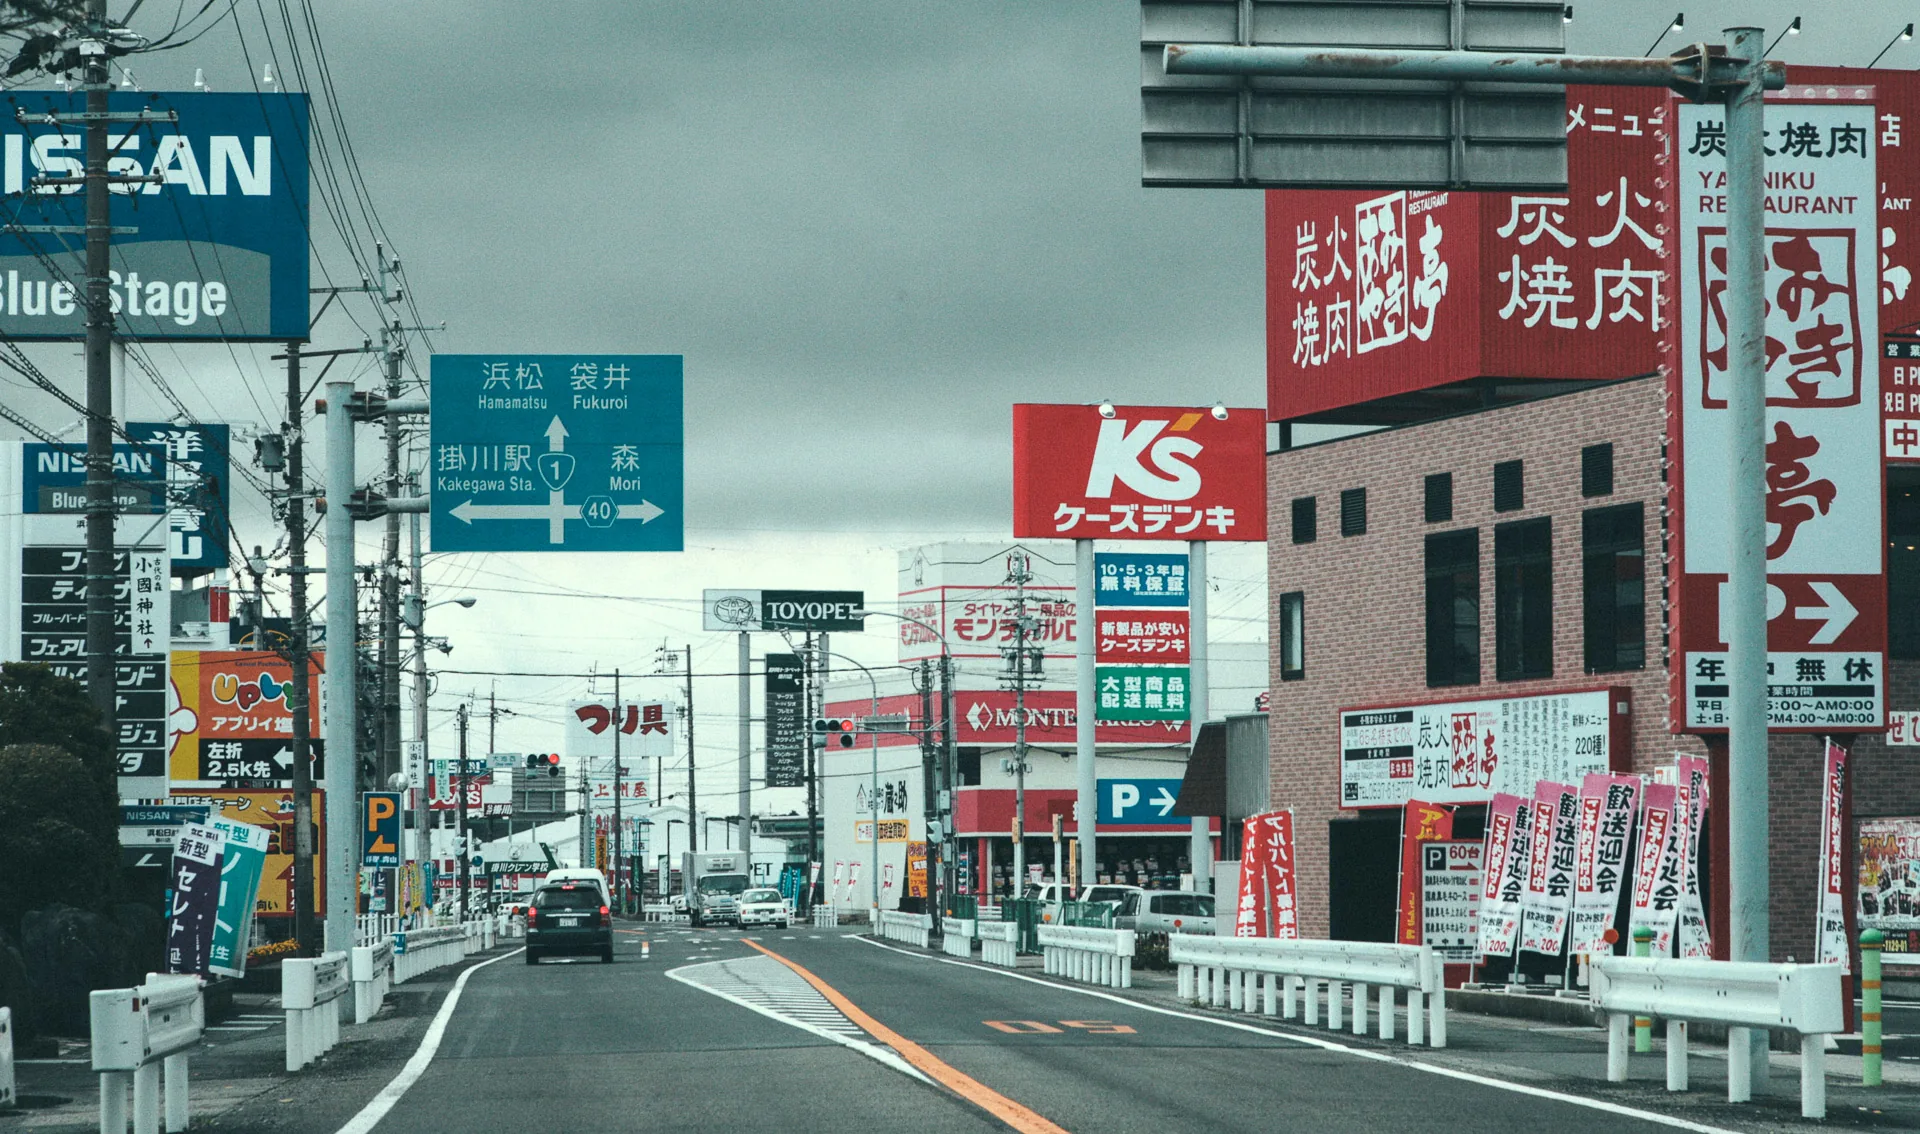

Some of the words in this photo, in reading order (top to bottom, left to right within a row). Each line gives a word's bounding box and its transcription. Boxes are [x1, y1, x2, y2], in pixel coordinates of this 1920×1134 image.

[1688, 119, 1867, 159] 炭焼肉
[1408, 192, 1449, 216] RESTAURANT
[1698, 195, 1858, 215] REAURANT
[1291, 215, 1352, 292] 炭火
[1497, 253, 1663, 333] 焼肉
[1291, 291, 1352, 369] 焼肉
[482, 362, 544, 390] 浜松
[569, 363, 631, 391] 袋井
[478, 395, 547, 410] Hamamatsu
[573, 395, 628, 410] Fukuroi
[37, 451, 153, 473] NISAN
[437, 444, 533, 472] 掛川駅
[610, 444, 640, 472] 森
[550, 460, 560, 481] 1
[437, 476, 505, 494] Kakegawa
[509, 476, 536, 492] Sta.
[609, 476, 641, 491] Mori
[588, 502, 611, 519] 40
[1053, 503, 1236, 535] ケーズデンキ
[1100, 576, 1186, 592] 無料保証
[135, 556, 154, 636] 小國神社
[766, 602, 859, 621] TOYOPET
[1101, 621, 1186, 637] 新製品が安い
[1101, 638, 1186, 653] ケーズデンキ
[1695, 657, 1875, 682] 年無休
[1101, 676, 1186, 692] 大型商品
[1101, 692, 1186, 709] 配送無料
[1696, 700, 1723, 711] 平日
[574, 703, 669, 736] つり具
[1417, 713, 1450, 750] 炭火
[207, 743, 242, 760] 左折
[1417, 755, 1450, 789] 焼肉
[1111, 784, 1140, 818] P
[126, 811, 170, 820] NISSAN
[368, 797, 395, 832] P
[178, 837, 209, 859] 新型
[1597, 784, 1635, 894] 歓送迎会
[1429, 849, 1442, 869] P
[1449, 845, 1481, 860] 60台
[490, 862, 550, 873] 掛川クレーン学校
